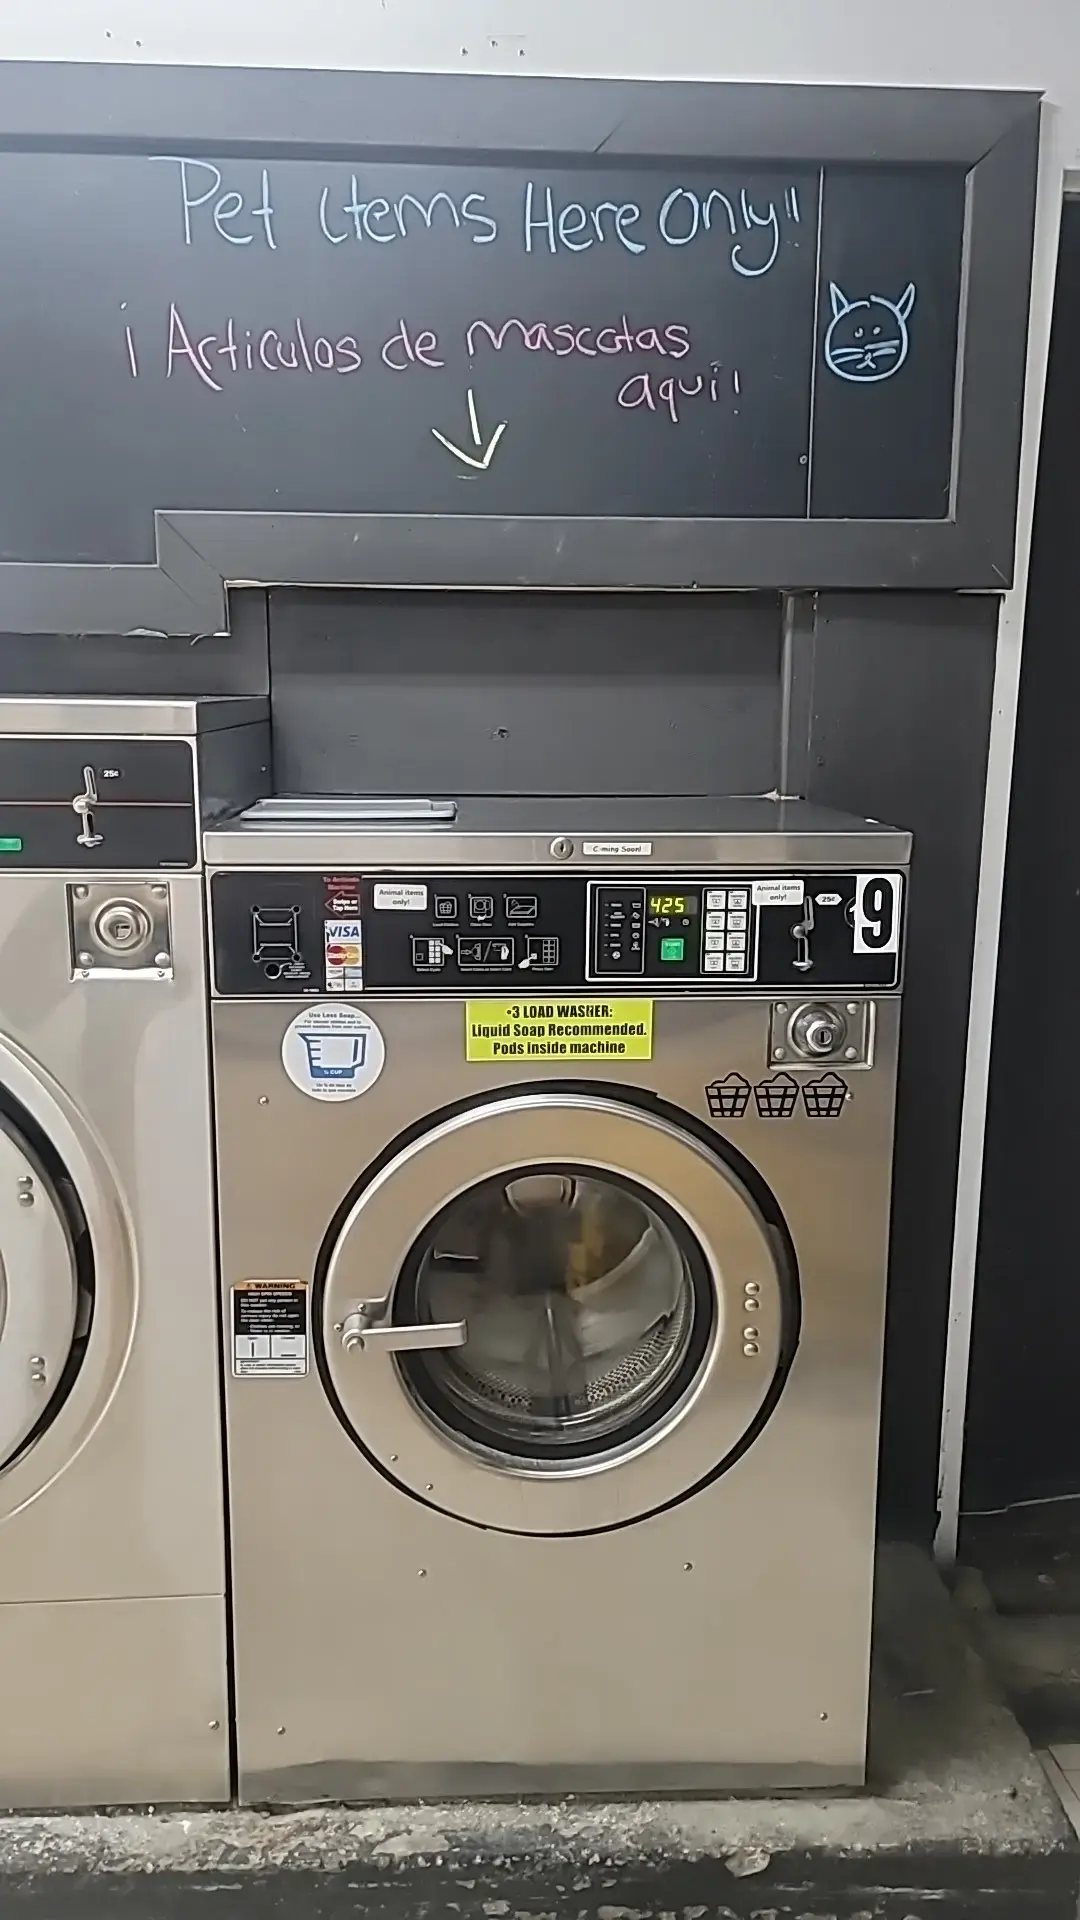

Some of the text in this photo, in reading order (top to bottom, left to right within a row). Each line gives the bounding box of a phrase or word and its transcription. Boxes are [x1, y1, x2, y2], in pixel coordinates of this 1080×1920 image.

[148, 155, 278, 250] Pet
[319, 174, 497, 244] Items
[525, 181, 647, 254] Here
[381, 318, 445, 371] de
[466, 314, 691, 359] mascotas
[592, 845, 619, 853] Cming
[392, 898, 410, 906] only!
[861, 877, 894, 949] 9
[328, 926, 360, 938] VISA
[523, 1005, 554, 1018] LOAD
[472, 1023, 647, 1039] Liquid Soap Recommended.
[493, 1041, 625, 1055] Pods inside machine
